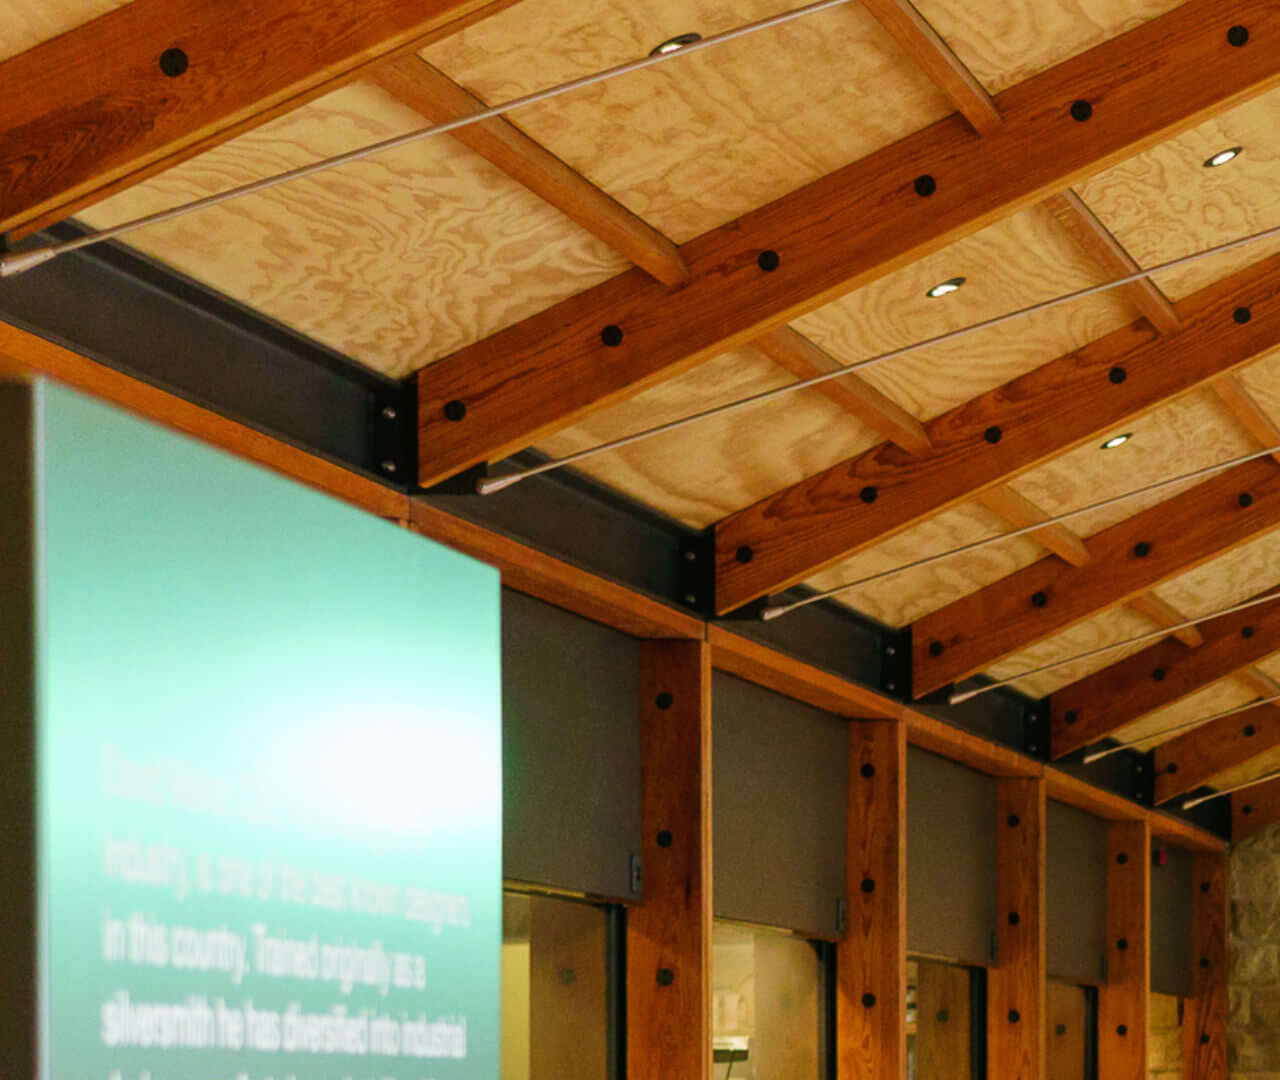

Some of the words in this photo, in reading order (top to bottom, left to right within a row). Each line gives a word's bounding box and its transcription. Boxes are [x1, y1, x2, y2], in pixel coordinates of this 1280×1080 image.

[102, 909, 126, 961] in
[129, 912, 169, 967] this
[252, 924, 319, 981] Trained
[393, 950, 414, 988] as
[414, 954, 426, 990] a
[101, 988, 213, 1048] silversmith
[215, 999, 243, 1050] he
[245, 999, 280, 1052] has
[370, 1011, 400, 1056] into
